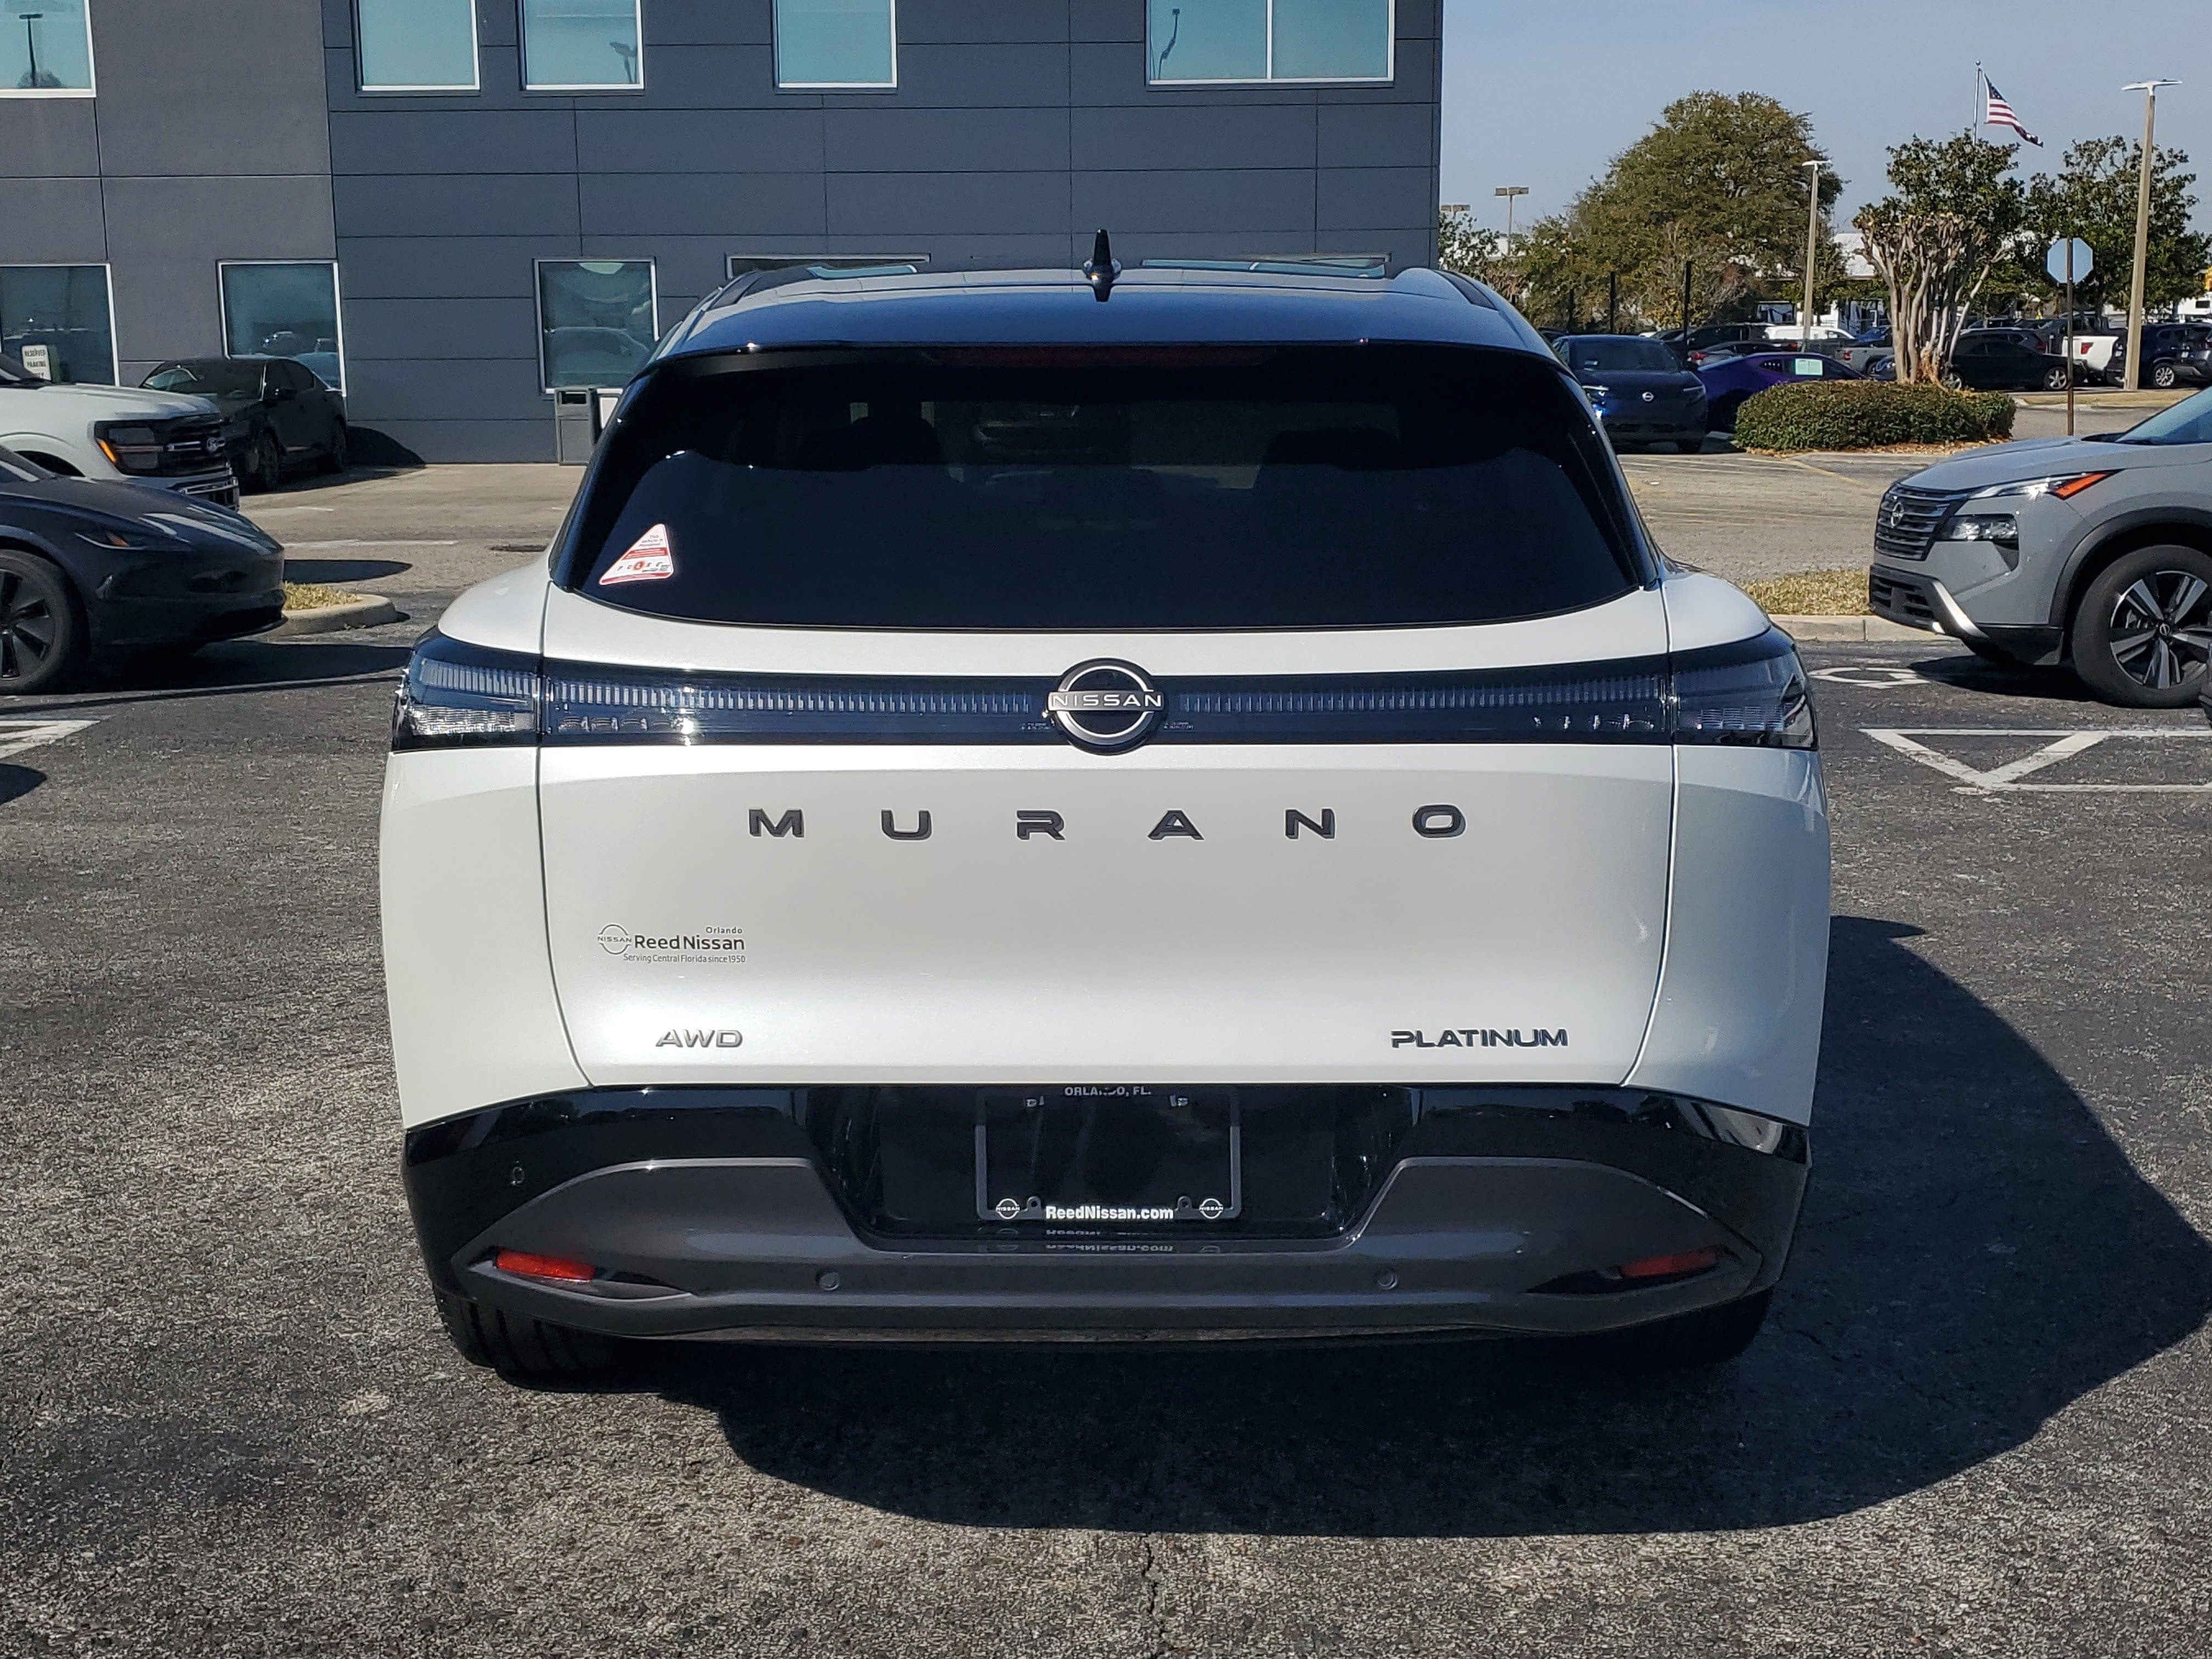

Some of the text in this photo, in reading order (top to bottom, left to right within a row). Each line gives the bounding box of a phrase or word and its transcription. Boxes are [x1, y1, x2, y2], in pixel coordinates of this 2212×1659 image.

[1052, 693, 1162, 708] NISSAN
[748, 804, 1466, 840] MURANO
[634, 934, 745, 950] Reed Nissan
[623, 953, 652, 963] Serving
[652, 954, 680, 962] Central
[681, 955, 707, 963] Florida
[728, 955, 746, 963] 1950
[655, 1029, 743, 1048] AWD
[1390, 1029, 1568, 1048] PLATINUM
[1133, 1086, 1152, 1095] FL.
[1046, 1205, 1174, 1220] ReedNissan.com
